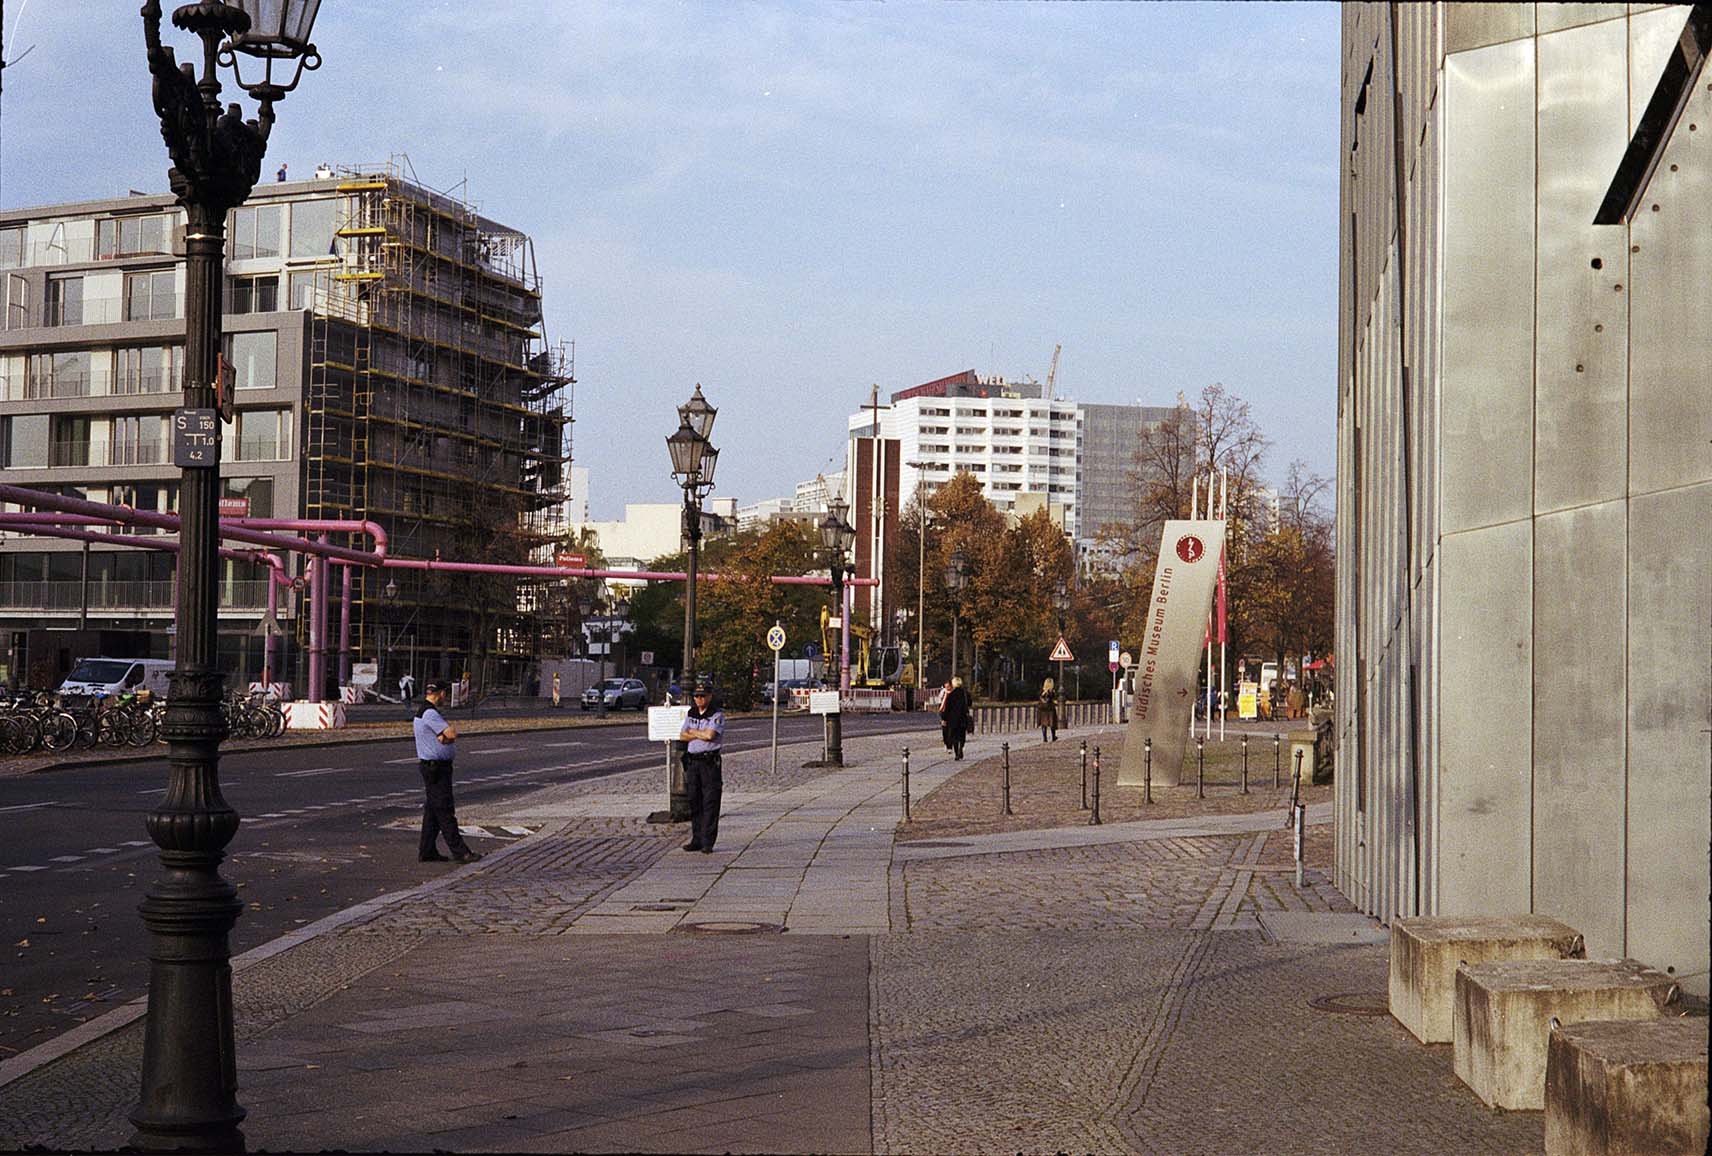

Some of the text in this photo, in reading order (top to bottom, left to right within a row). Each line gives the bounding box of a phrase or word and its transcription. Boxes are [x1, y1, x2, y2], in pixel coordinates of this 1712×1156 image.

[177, 416, 214, 430] S 150
[202, 437, 214, 446] 1.0
[189, 451, 203, 460] 4.2
[1135, 567, 1173, 720] Jüdisches Museum Berlin
